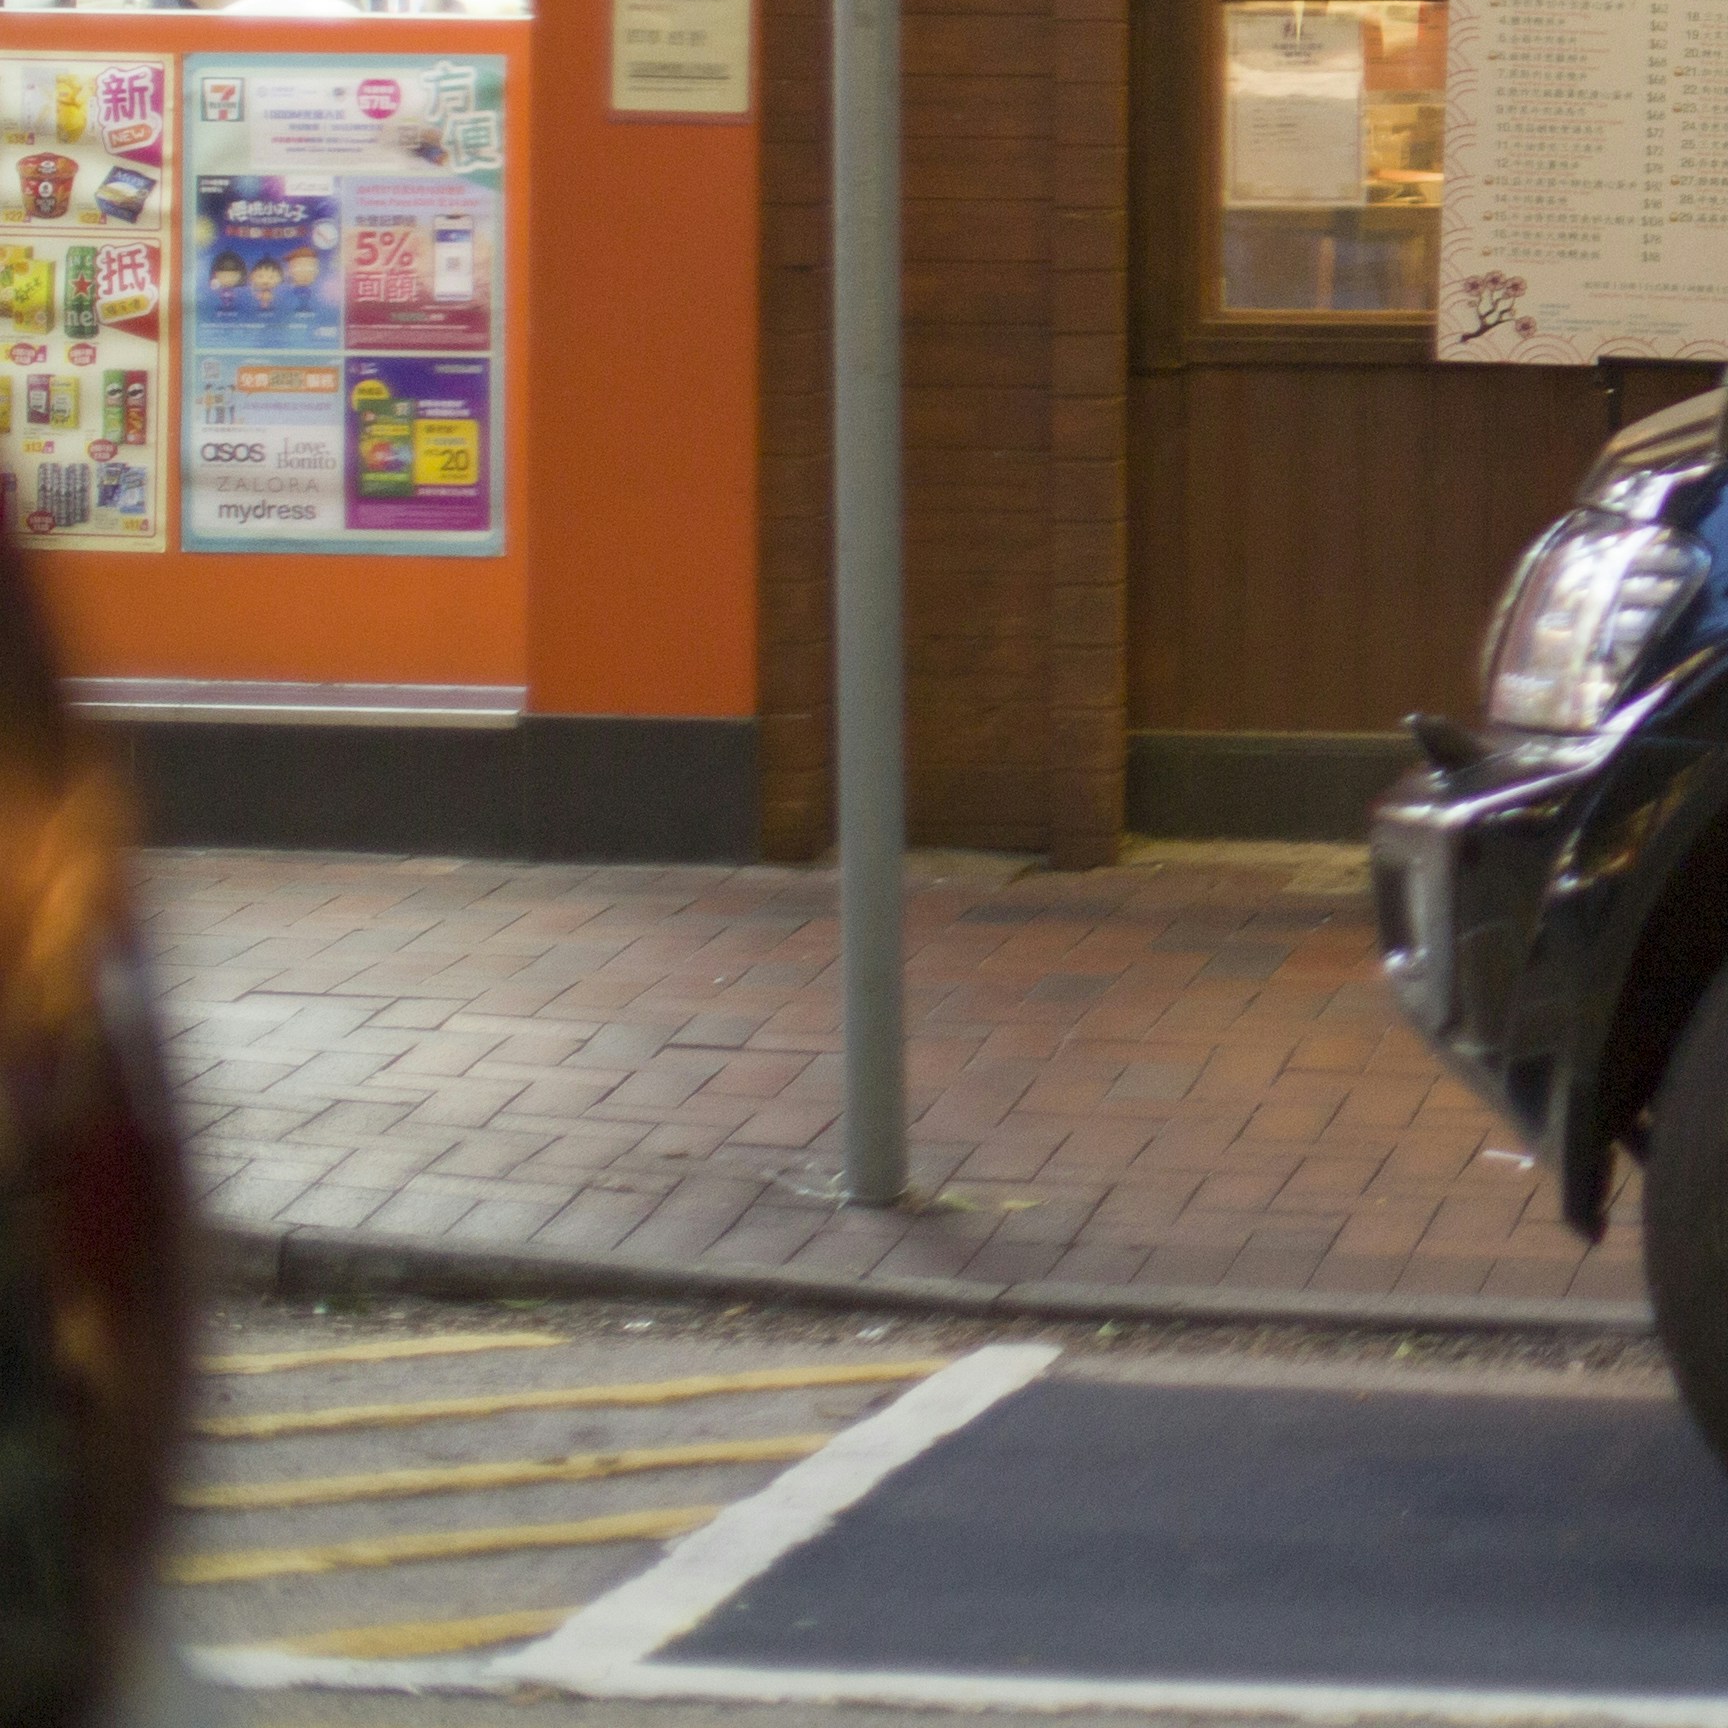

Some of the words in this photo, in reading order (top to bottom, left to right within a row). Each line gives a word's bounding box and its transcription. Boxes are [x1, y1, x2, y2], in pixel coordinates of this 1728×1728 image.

[102, 73, 149, 122] 新
[112, 125, 146, 146] NEW
[356, 230, 413, 268] 5%
[102, 248, 146, 296] 抵
[201, 441, 266, 463] asos
[277, 452, 337, 471] Bonito
[439, 449, 469, 472] 20
[217, 476, 319, 494] ZALORA
[218, 501, 317, 524] mydress
